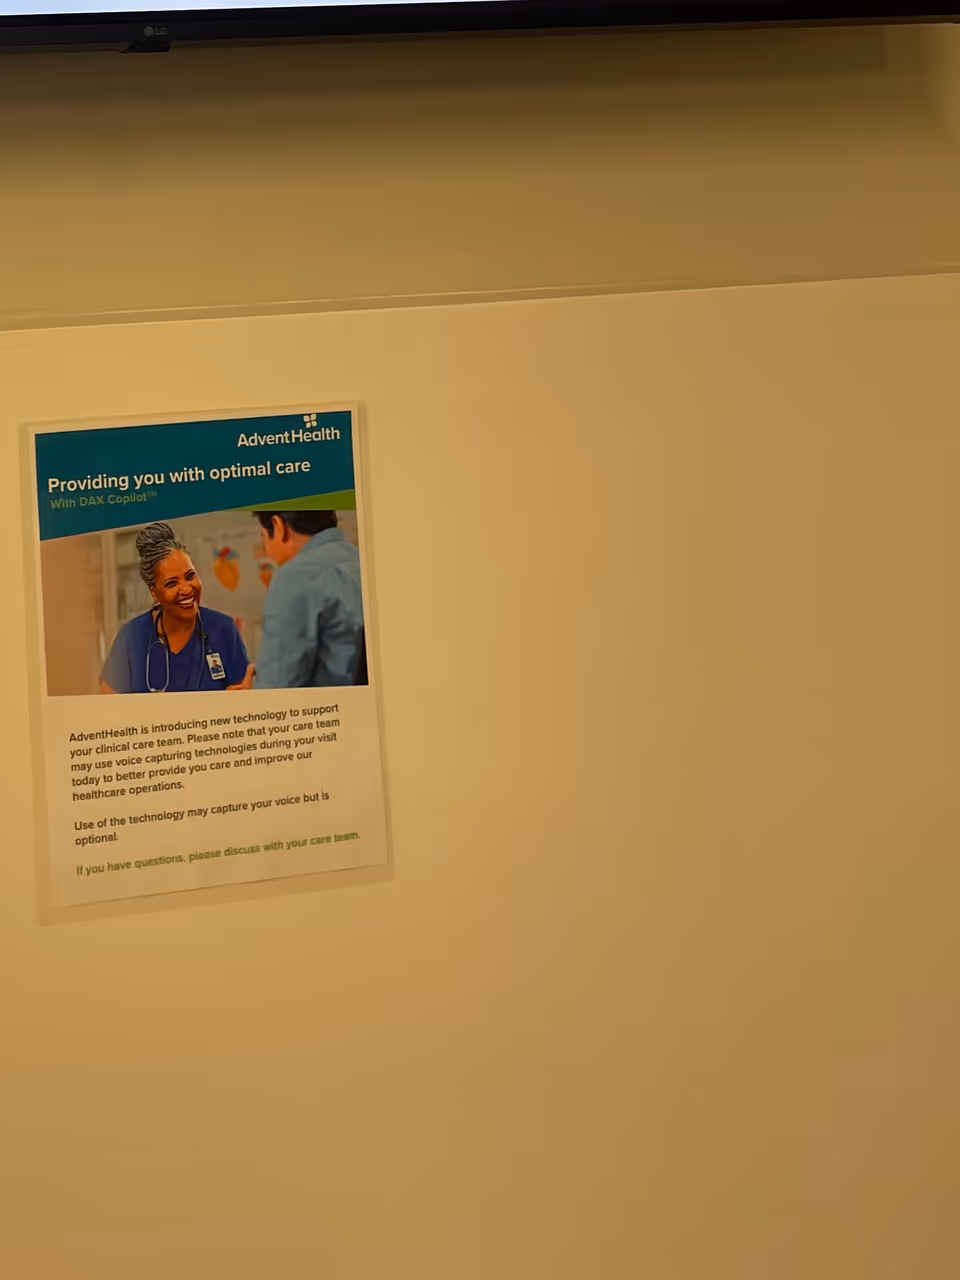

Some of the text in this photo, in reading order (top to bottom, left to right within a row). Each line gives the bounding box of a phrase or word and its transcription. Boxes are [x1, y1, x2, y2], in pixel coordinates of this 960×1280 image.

[237, 427, 340, 447] AdventHealth
[48, 459, 311, 493] Providing you with optimal care
[50, 498, 76, 509] With
[80, 495, 104, 506] DAX
[69, 704, 339, 742] AdventHealth is introducing new technology to support
[70, 718, 340, 759] your clinical care team. Please note that your care team
[71, 732, 337, 773] may use voice capturing technologies during your visit
[72, 750, 312, 787] today to better provide you care and improve our
[73, 780, 185, 801] healthcare operations.
[74, 790, 329, 831] Use of the technology may capture your voice but is
[75, 832, 119, 847] optional.
[77, 831, 360, 876] If you have questions, please discuss with your care team.
